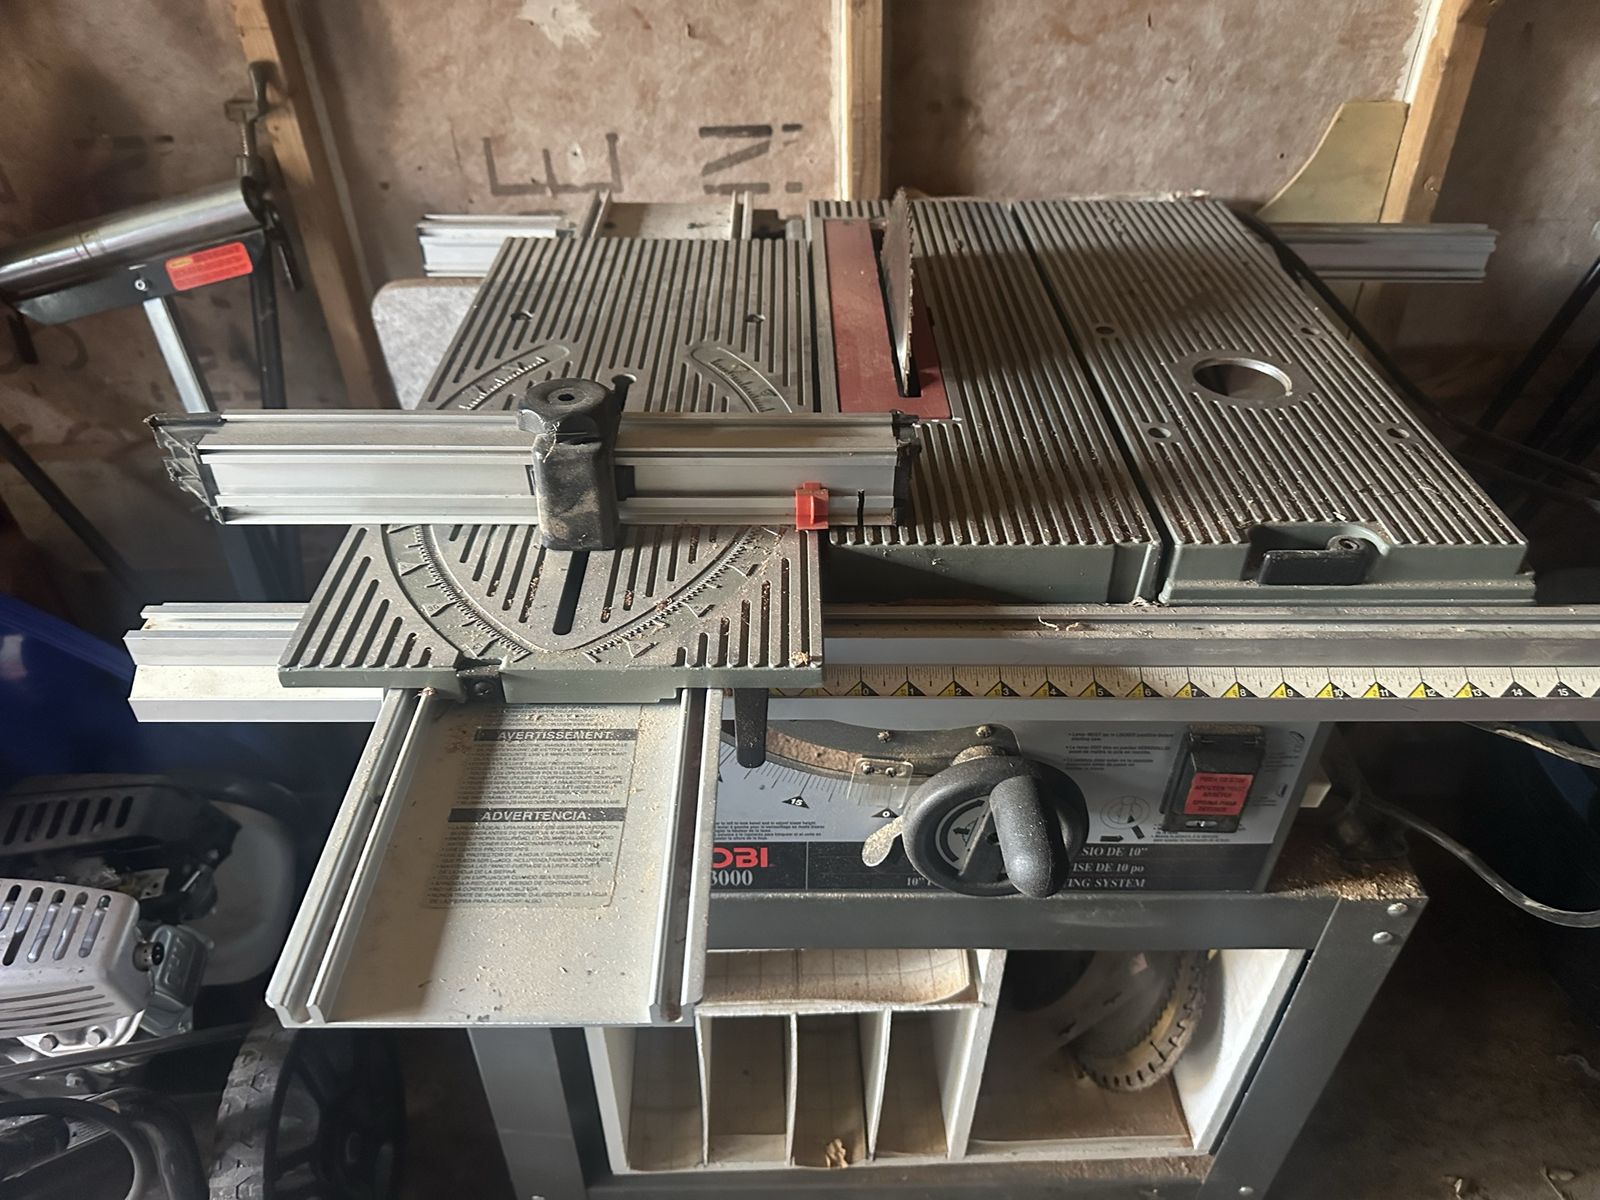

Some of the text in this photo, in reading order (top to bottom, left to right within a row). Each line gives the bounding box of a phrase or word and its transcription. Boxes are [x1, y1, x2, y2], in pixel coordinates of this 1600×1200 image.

[863, 688, 1568, 697] 0 1 2 3 4 5 6 7 8 9 10 11 12 13 14 15
[791, 798, 803, 806] 15
[481, 811, 591, 821] ADVERTENCIA:
[1106, 847, 1125, 856] DE
[1095, 862, 1114, 872] DE
[1116, 863, 1129, 872] 10
[1130, 865, 1145, 874] po
[1094, 878, 1146, 888] SYSTEM
